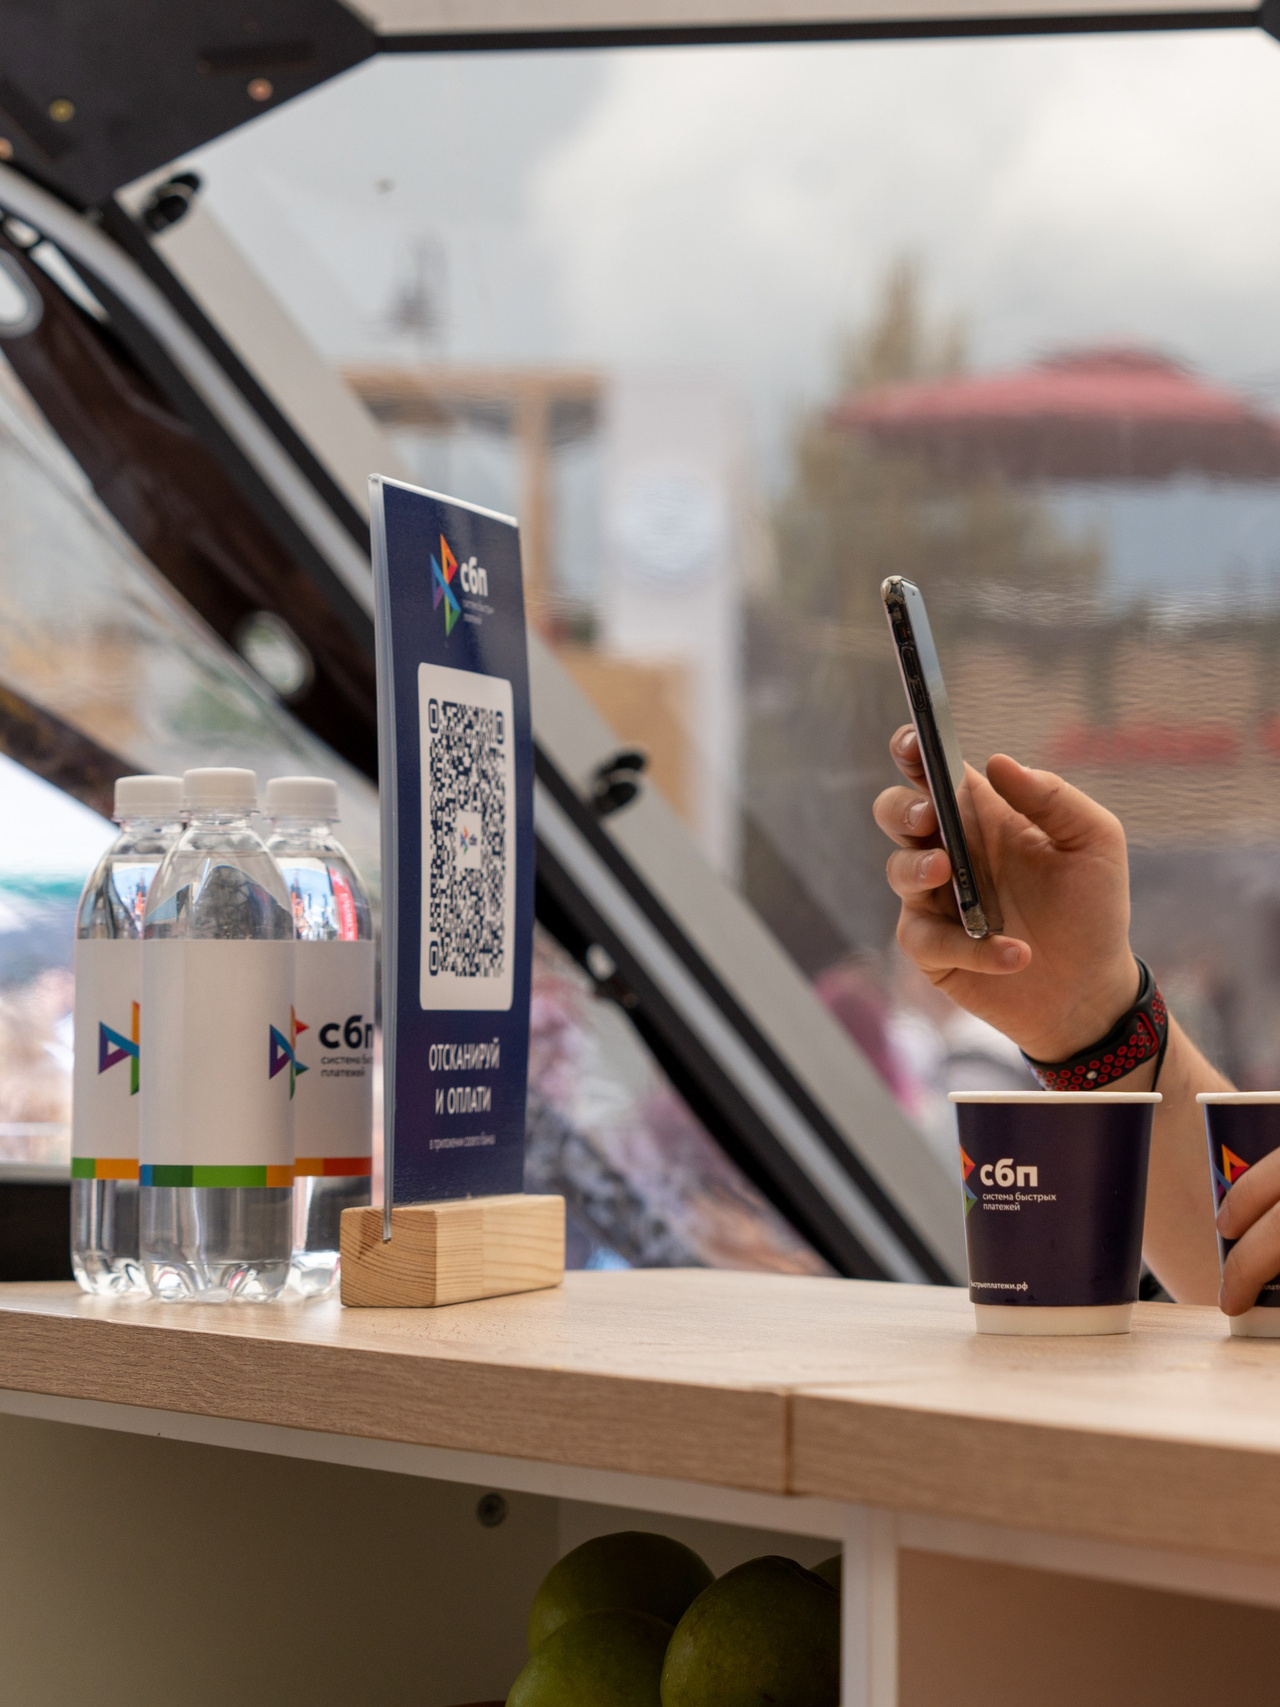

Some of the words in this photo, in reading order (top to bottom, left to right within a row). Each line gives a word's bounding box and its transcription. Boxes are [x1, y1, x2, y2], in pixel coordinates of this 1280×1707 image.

[460, 556, 489, 597] сбп
[428, 1037, 500, 1071] ОТСКАНИРУЙ
[435, 1088, 444, 1114] И
[447, 1086, 491, 1114] ОПЛАТИ
[980, 1158, 1038, 1188] сбп
[982, 1193, 1013, 1201] система
[1015, 1191, 1057, 1203] быстрых
[983, 1202, 1020, 1211] платежей
